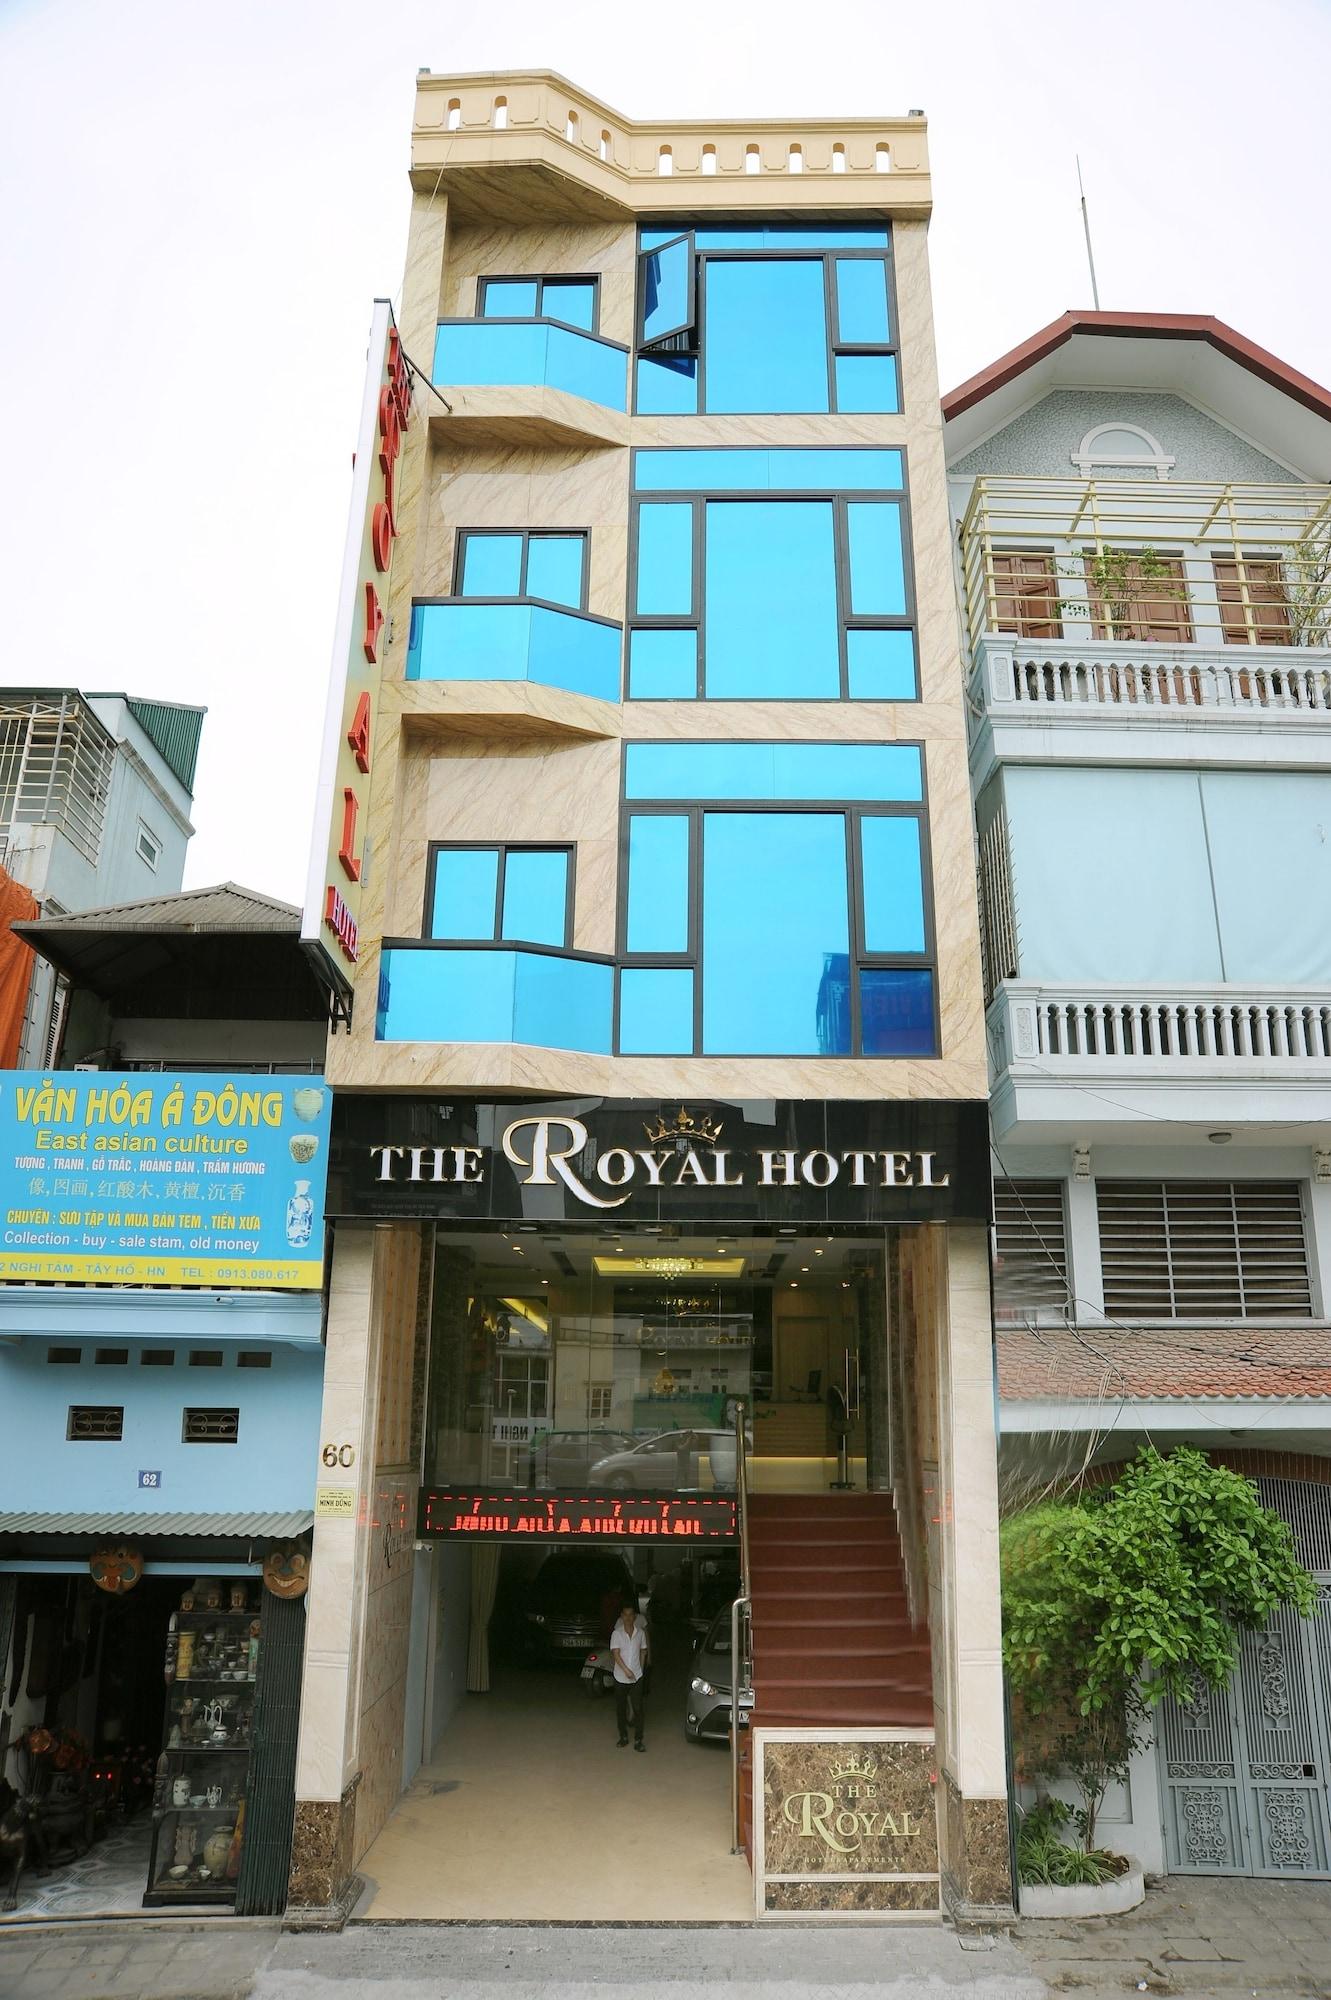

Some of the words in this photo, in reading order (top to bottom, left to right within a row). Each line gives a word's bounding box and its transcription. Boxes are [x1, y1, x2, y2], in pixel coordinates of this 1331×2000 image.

[15, 1078, 77, 1126] VĂN
[84, 1080, 153, 1128] HÓA
[161, 1082, 185, 1129] Á
[191, 1083, 283, 1127] ĐÔNG
[35, 1130, 88, 1151] East
[93, 1132, 157, 1152] asian
[164, 1134, 248, 1155] culture
[53, 1158, 84, 1170] TRANH
[370, 1146, 485, 1183] THE
[502, 1116, 744, 1208] ROYAL
[757, 1149, 950, 1187] HOTEL
[124, 1213, 149, 1228] MUA
[179, 1214, 201, 1229] TEM
[4, 1230, 70, 1245] Collection
[82, 1233, 107, 1249] buy
[119, 1233, 146, 1248] sale
[189, 1236, 211, 1249] old
[214, 1240, 260, 1254] money
[9, 1262, 42, 1273] NGHI
[147, 1266, 166, 1277] HN
[180, 1267, 206, 1278] TEL
[217, 1268, 299, 1280] 0913.080.617
[322, 1443, 356, 1468] 60
[142, 1473, 157, 1486] 62
[832, 1785, 877, 1798] THE
[784, 1792, 921, 1853] ROYAL
